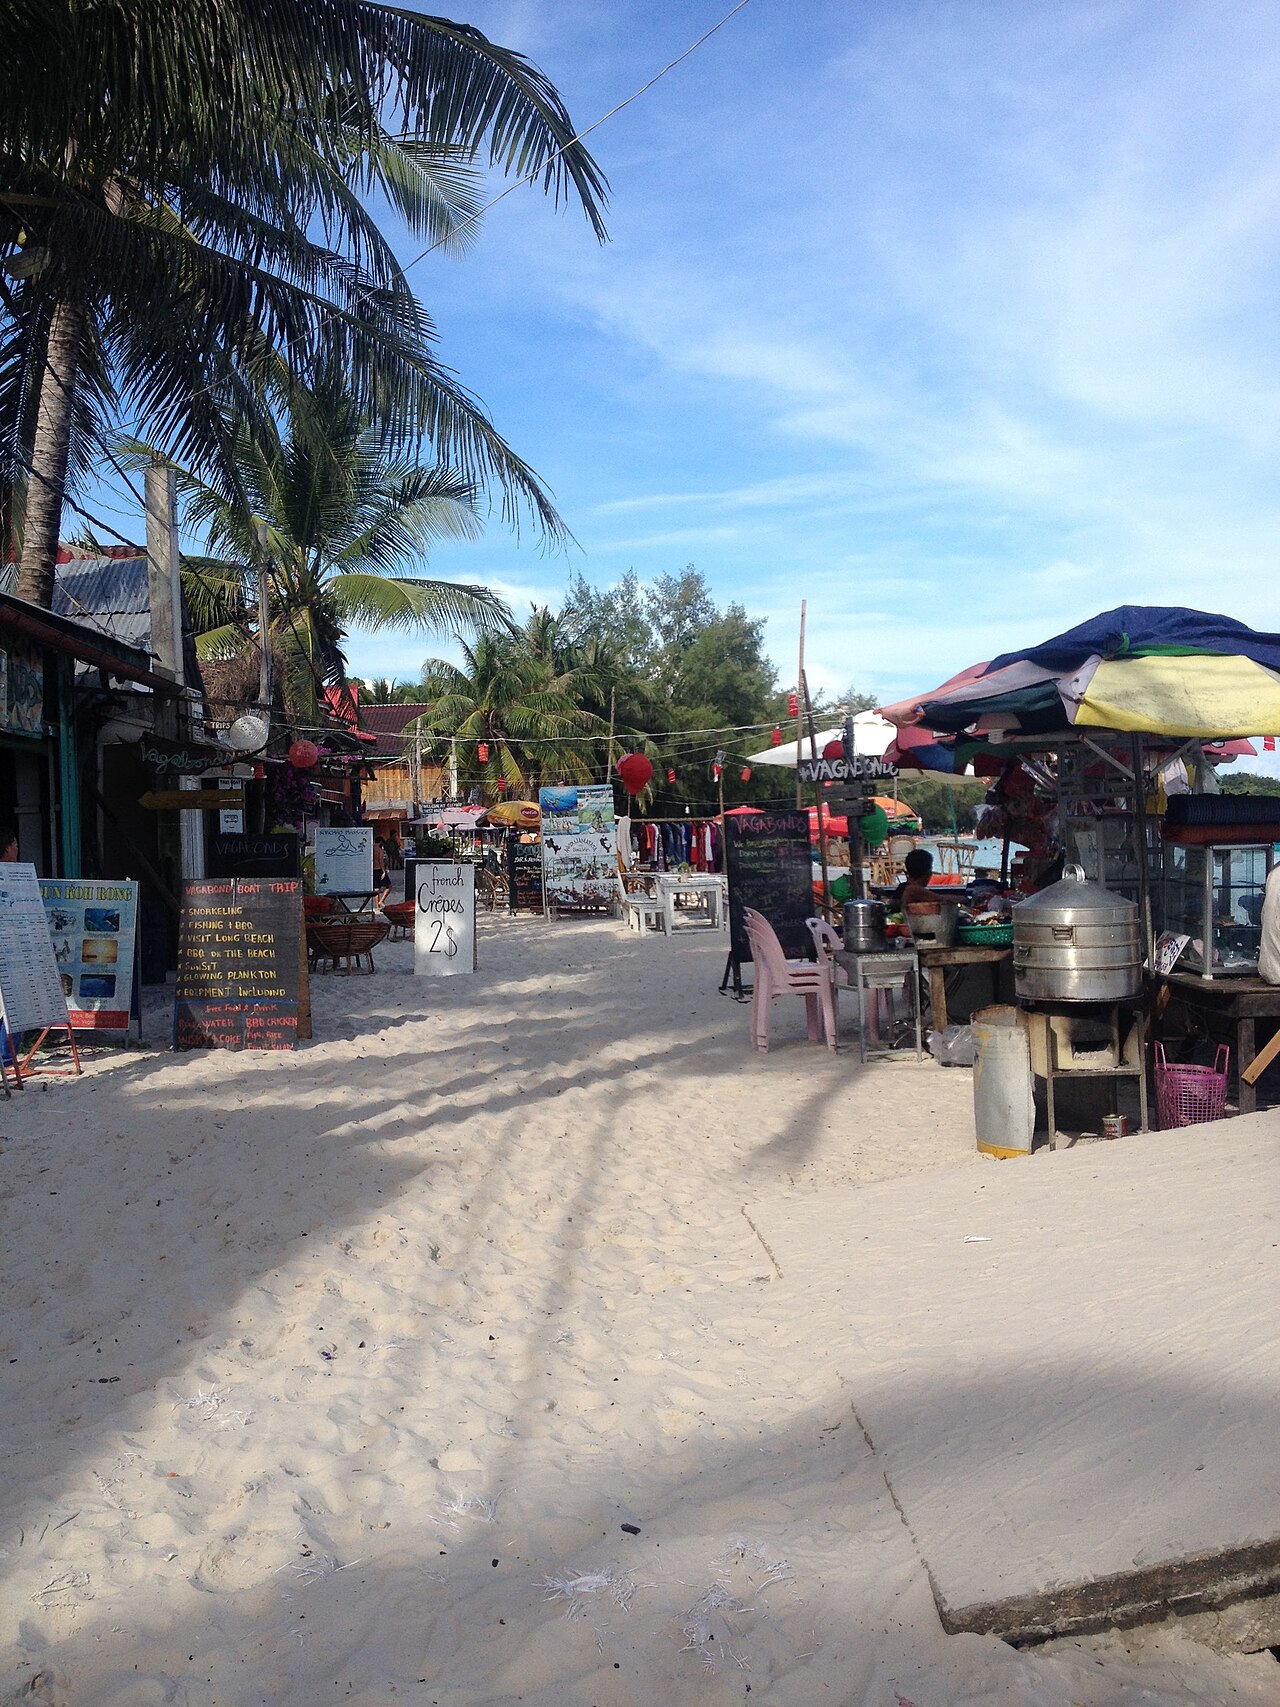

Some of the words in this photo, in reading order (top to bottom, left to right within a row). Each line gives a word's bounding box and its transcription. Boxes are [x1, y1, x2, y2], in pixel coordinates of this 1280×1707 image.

[209, 720, 231, 729] TRIPS
[730, 814, 808, 834] VAGABONDS
[429, 866, 465, 896] french
[64, 886, 93, 900] KOH
[96, 886, 132, 901] RONG
[184, 884, 233, 896] VAGABOND
[236, 882, 262, 894] BOAT
[268, 882, 300, 894] TRIP
[417, 882, 465, 925] Crêpes
[188, 906, 243, 916] SNORKELING
[188, 921, 224, 930] FISHING
[235, 921, 254, 930] BBQ
[187, 934, 212, 943] VISIT
[215, 934, 241, 943] LONG
[244, 934, 275, 943] BEACH
[186, 949, 206, 958] BBQ
[224, 949, 243, 958] THE
[247, 949, 276, 958] BEACH
[184, 972, 223, 982] GLOWING
[227, 970, 277, 980] PLANKTON
[202, 1017, 236, 1028] WATER
[245, 1017, 265, 1028] BBQ
[267, 1017, 298, 1027] CHICKEN
[219, 1033, 242, 1044] COKE
